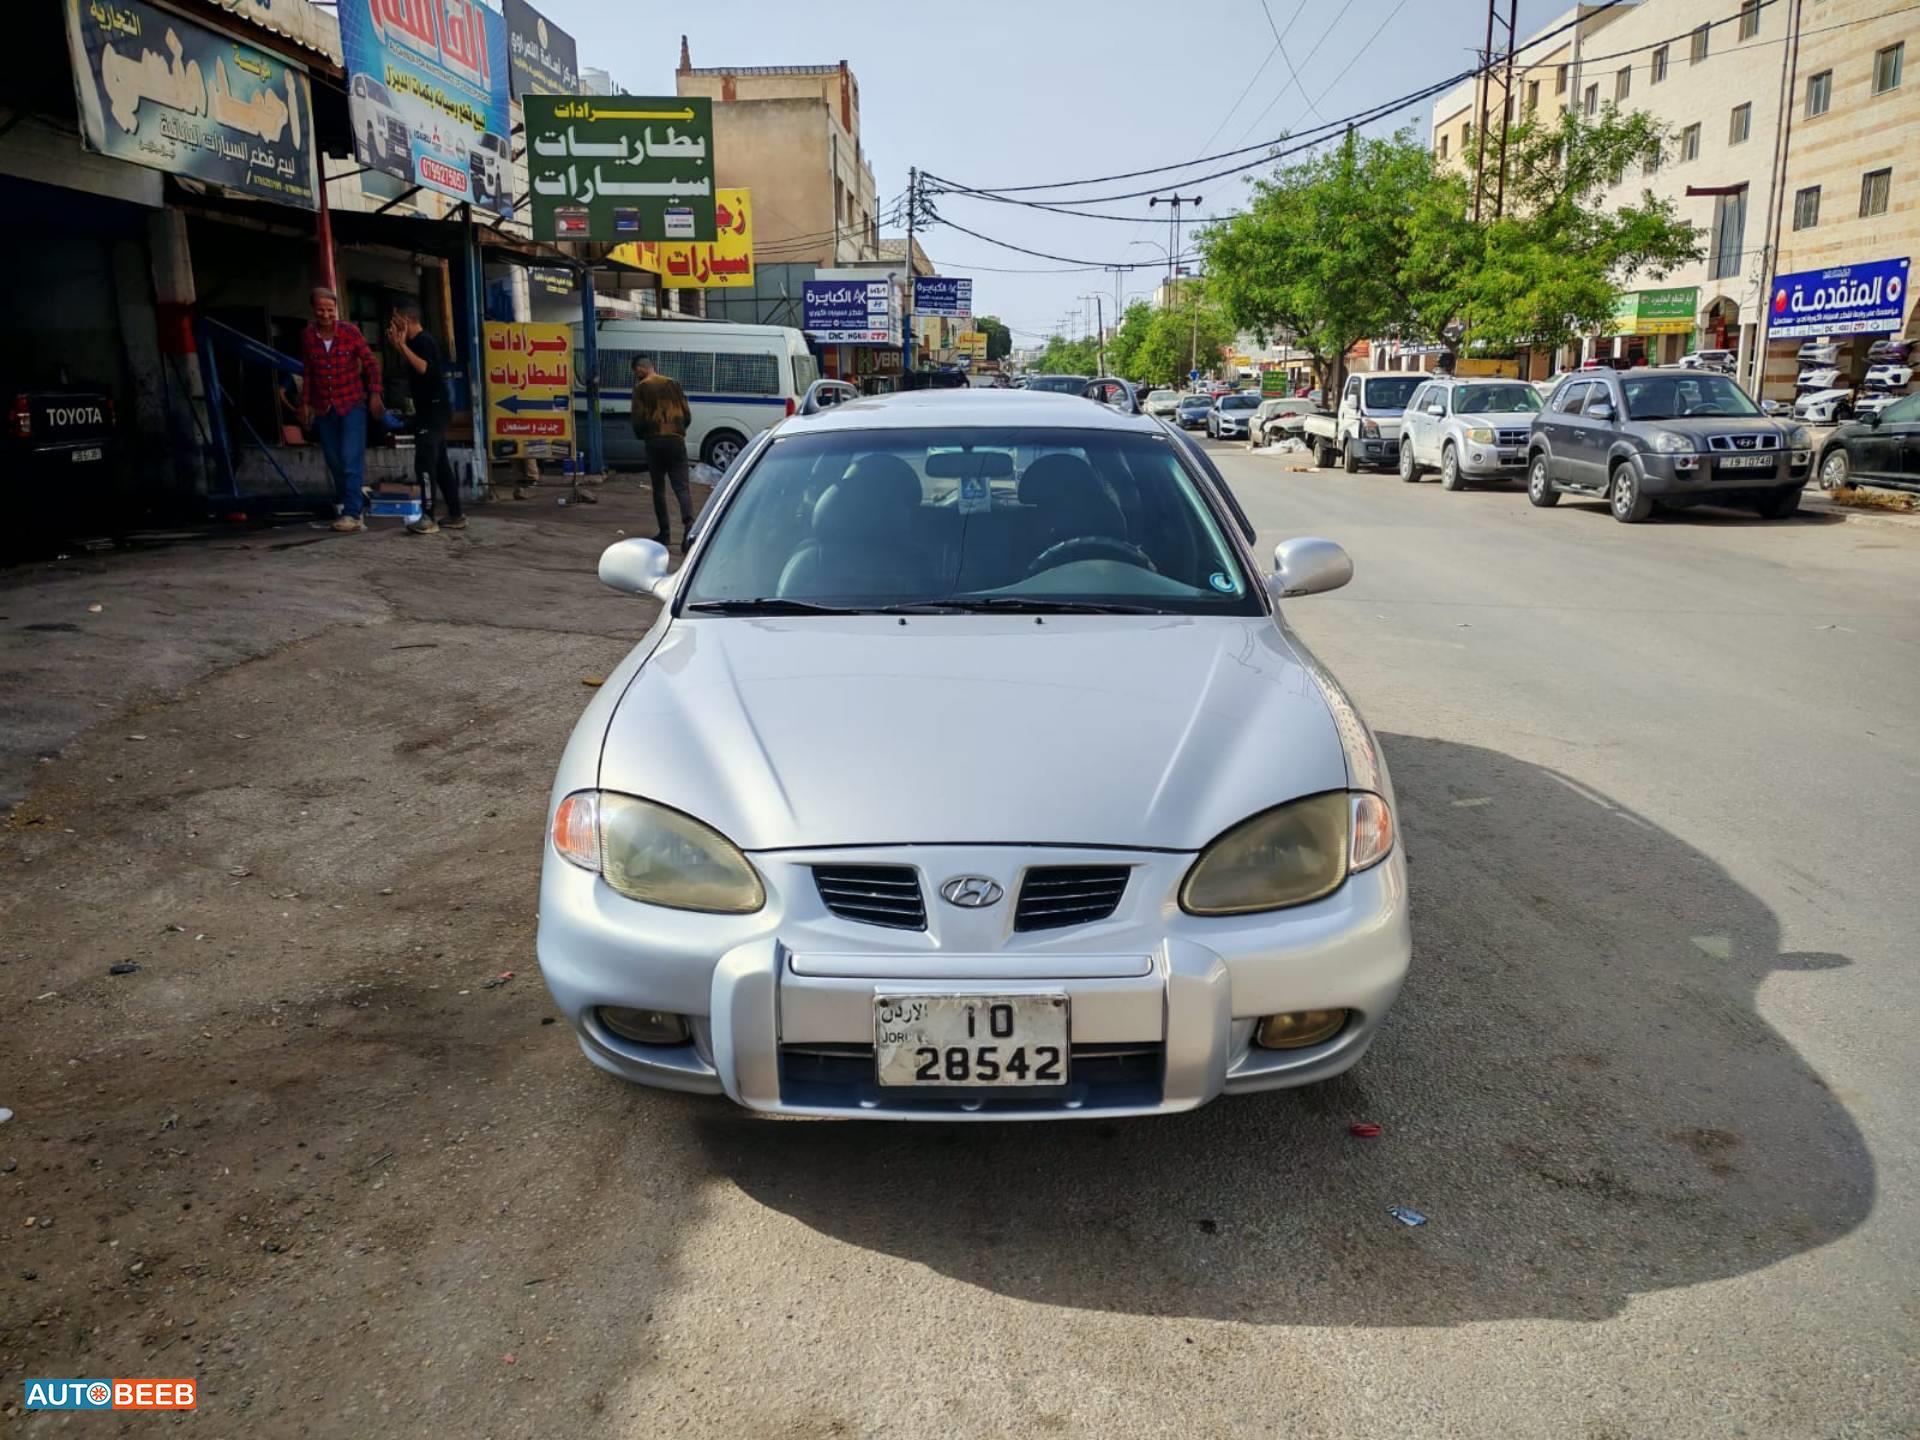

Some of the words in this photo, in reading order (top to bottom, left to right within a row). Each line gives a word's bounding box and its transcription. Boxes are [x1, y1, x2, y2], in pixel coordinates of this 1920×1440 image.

[554, 101, 695, 122] جرادات
[203, 132, 248, 161] السيارات
[250, 147, 276, 168] قطع
[534, 125, 706, 165] بطاريات
[534, 164, 711, 203] سيارات
[667, 245, 750, 283] سيارات
[1791, 276, 1882, 313] المتقدمة
[489, 329, 568, 357] جرادات
[490, 362, 568, 391] للبطاريات
[46, 407, 103, 426] TOYOTA
[916, 1047, 1061, 1081] 28542
